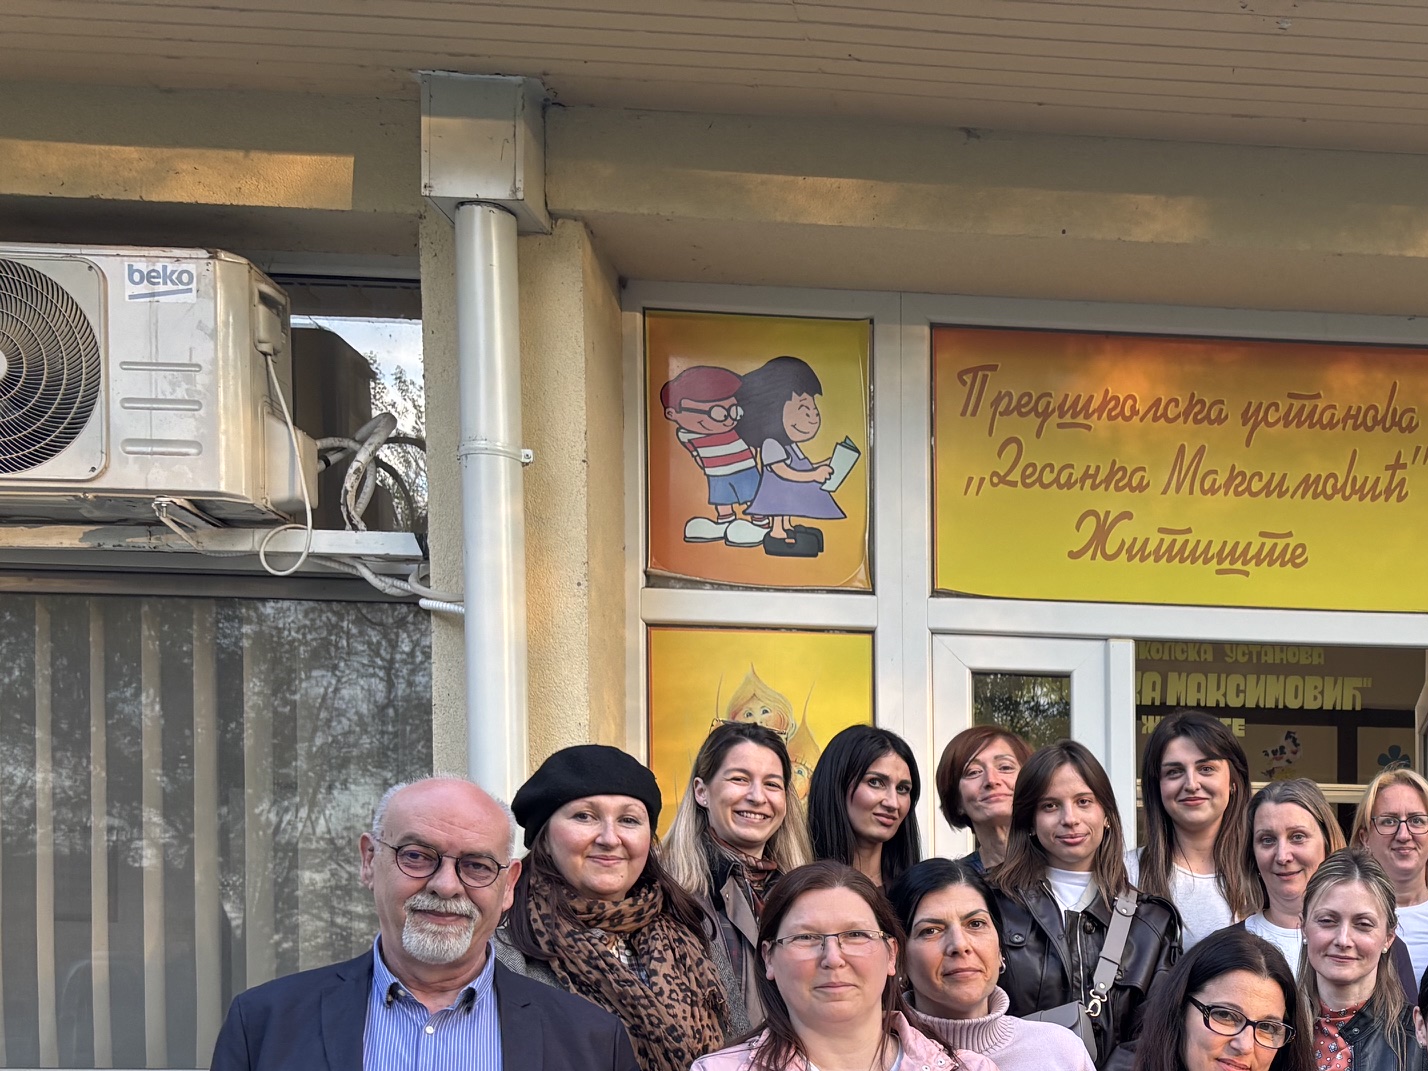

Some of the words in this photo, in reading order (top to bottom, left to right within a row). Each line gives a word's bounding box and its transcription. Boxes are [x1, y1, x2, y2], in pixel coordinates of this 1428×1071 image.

[127, 264, 194, 287] beko
[955, 363, 1230, 440] Предшколска
[1241, 381, 1420, 448] установа
[1067, 509, 1309, 579] Житиште
[1224, 643, 1325, 665] УСТАНОВА
